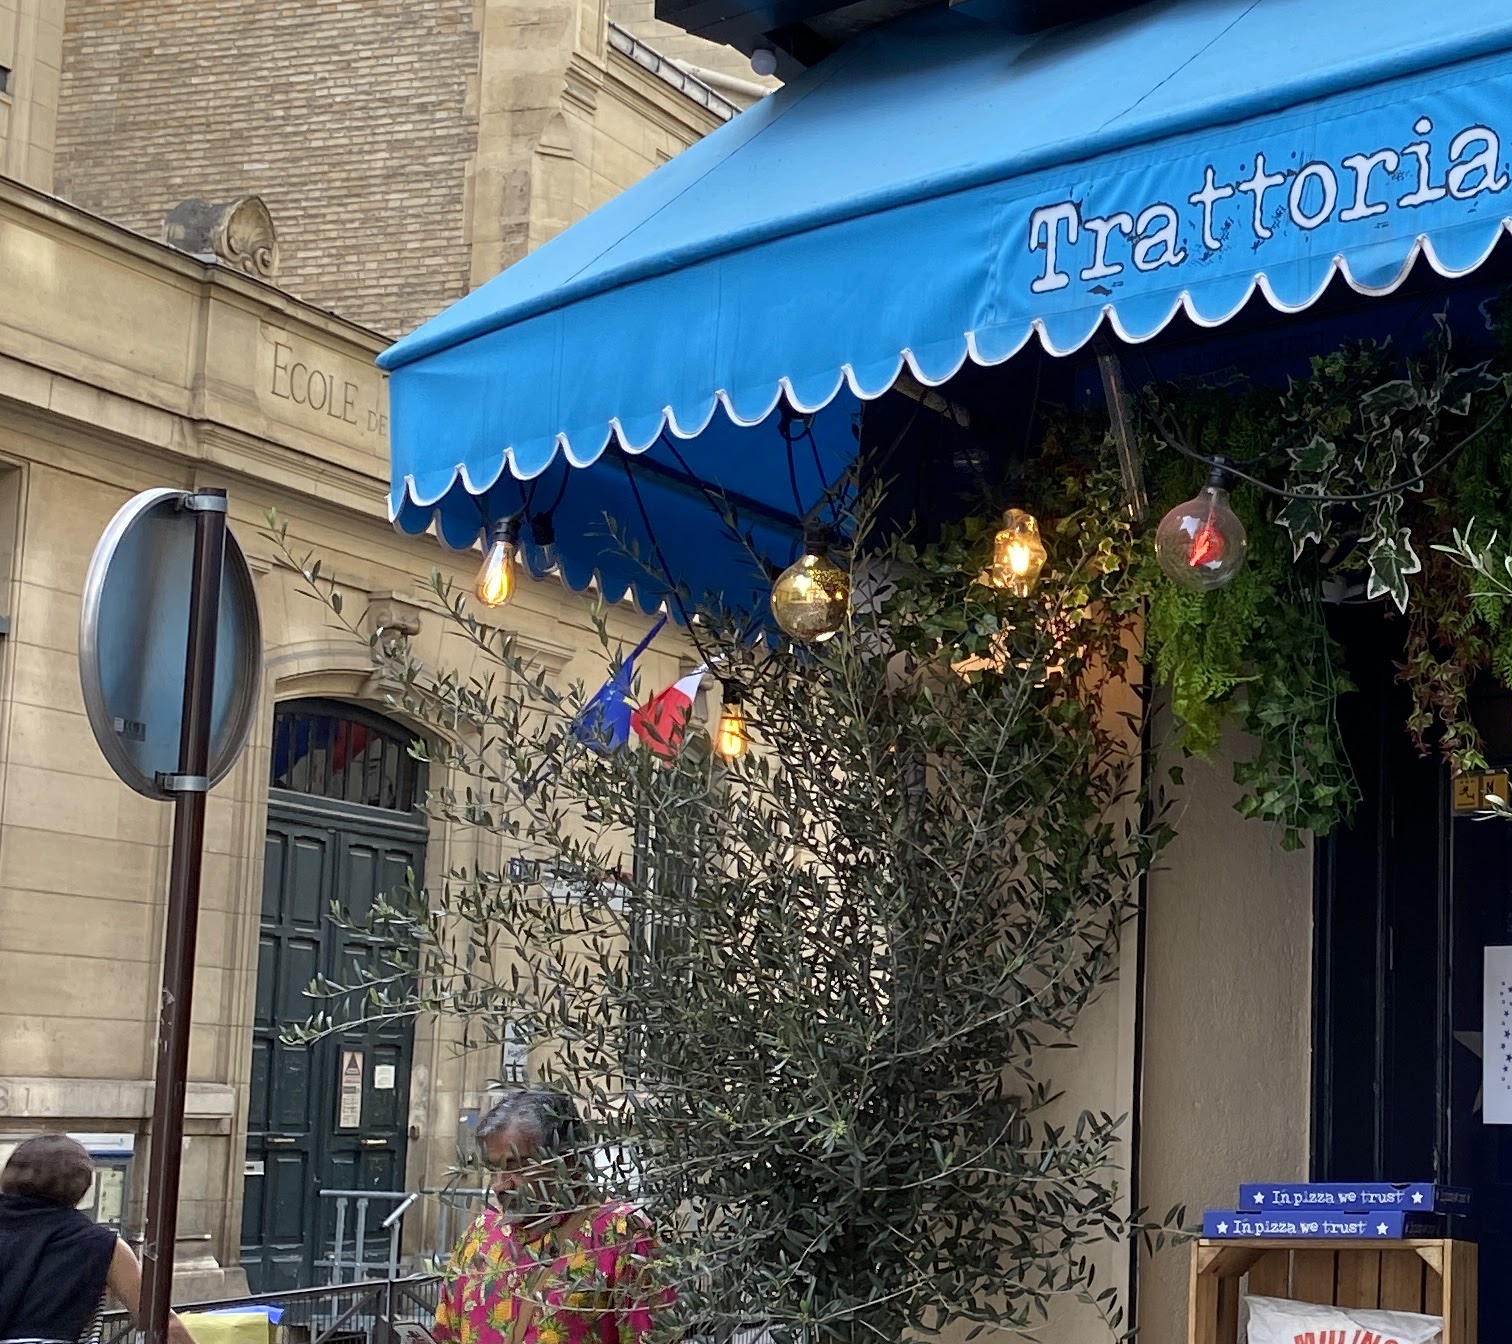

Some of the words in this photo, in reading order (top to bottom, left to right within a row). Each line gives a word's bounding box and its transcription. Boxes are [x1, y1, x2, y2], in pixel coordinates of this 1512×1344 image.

[1027, 115, 1511, 294] Trattoria
[271, 341, 359, 426] ECOLE
[1271, 1189, 1291, 1205] In
[1293, 1189, 1335, 1207] pizza
[1338, 1190, 1357, 1204] we
[1360, 1189, 1405, 1205] trust
[1232, 1218, 1252, 1235] In
[1254, 1219, 1297, 1238] pizza
[1299, 1220, 1319, 1234] we
[1321, 1219, 1367, 1235] trust
